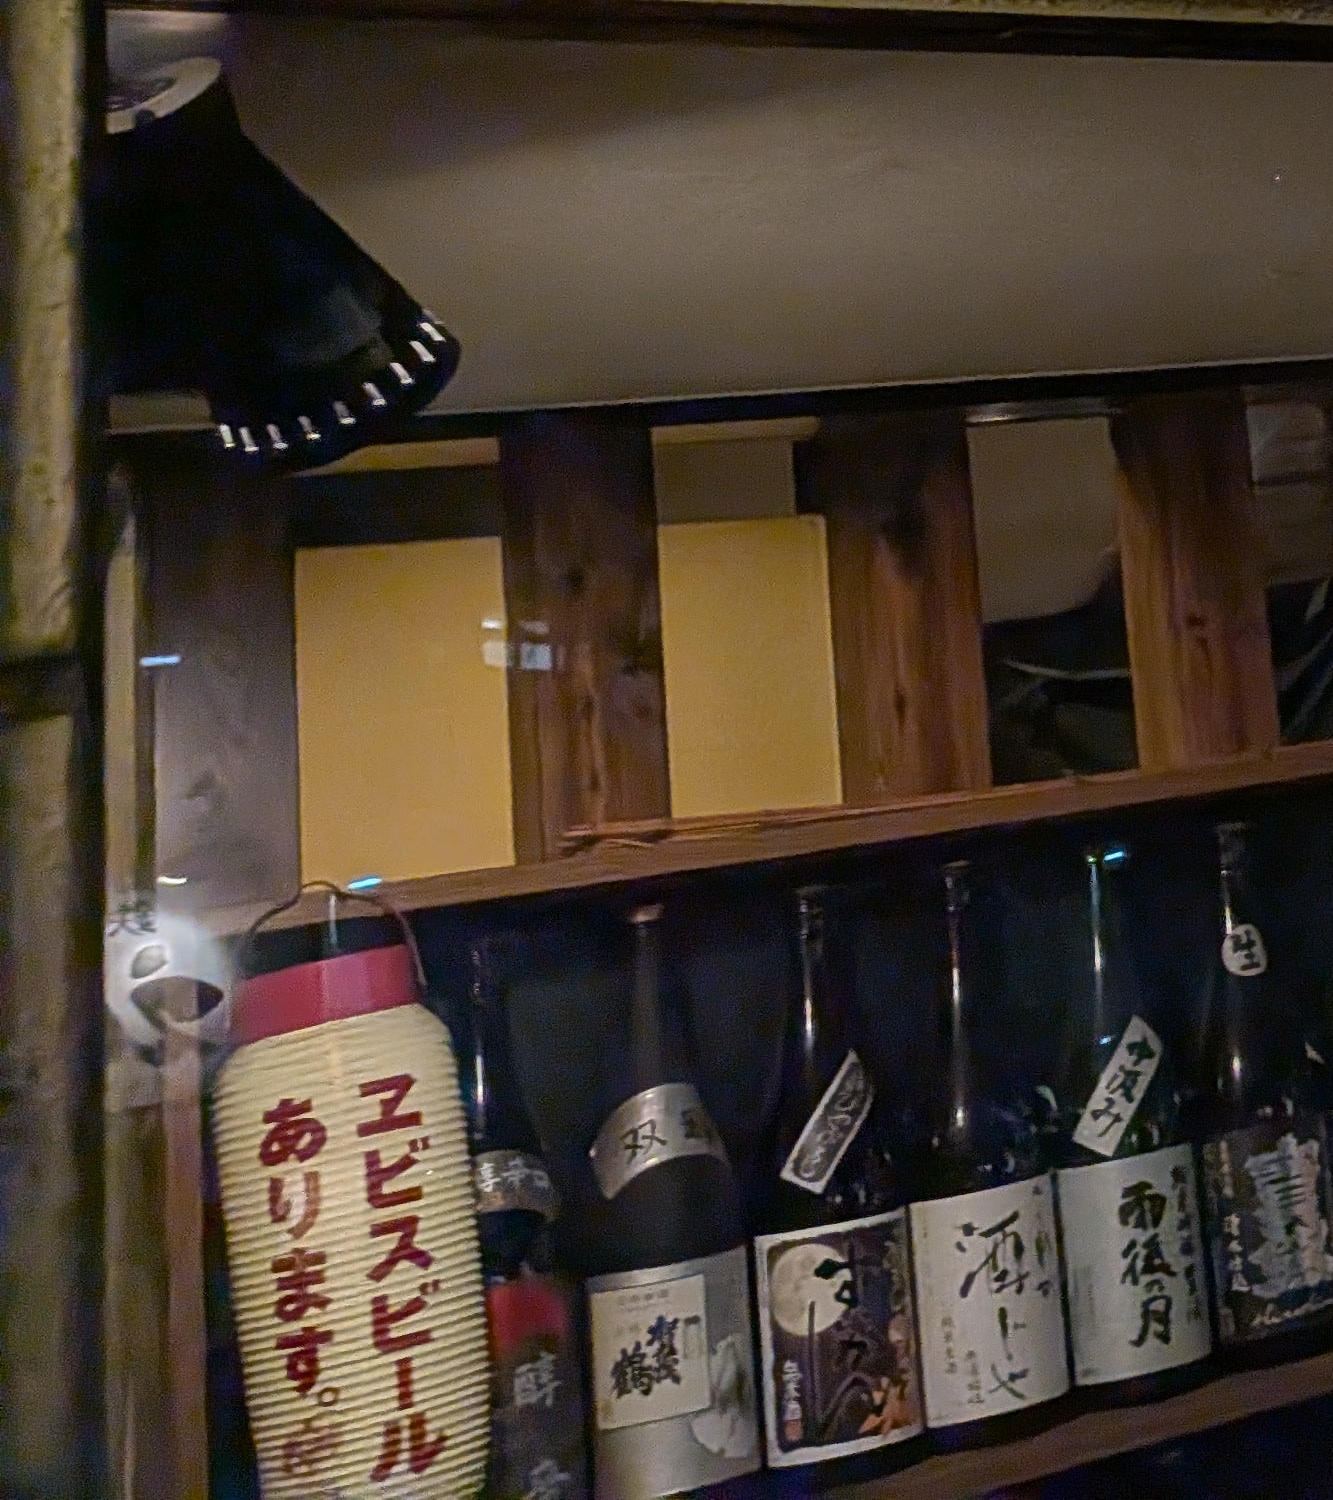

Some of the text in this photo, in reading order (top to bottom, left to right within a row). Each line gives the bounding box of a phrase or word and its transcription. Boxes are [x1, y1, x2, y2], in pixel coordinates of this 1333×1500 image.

[259, 1097, 341, 1409] あります。
[1118, 1180, 1179, 1348] 雨後の月
